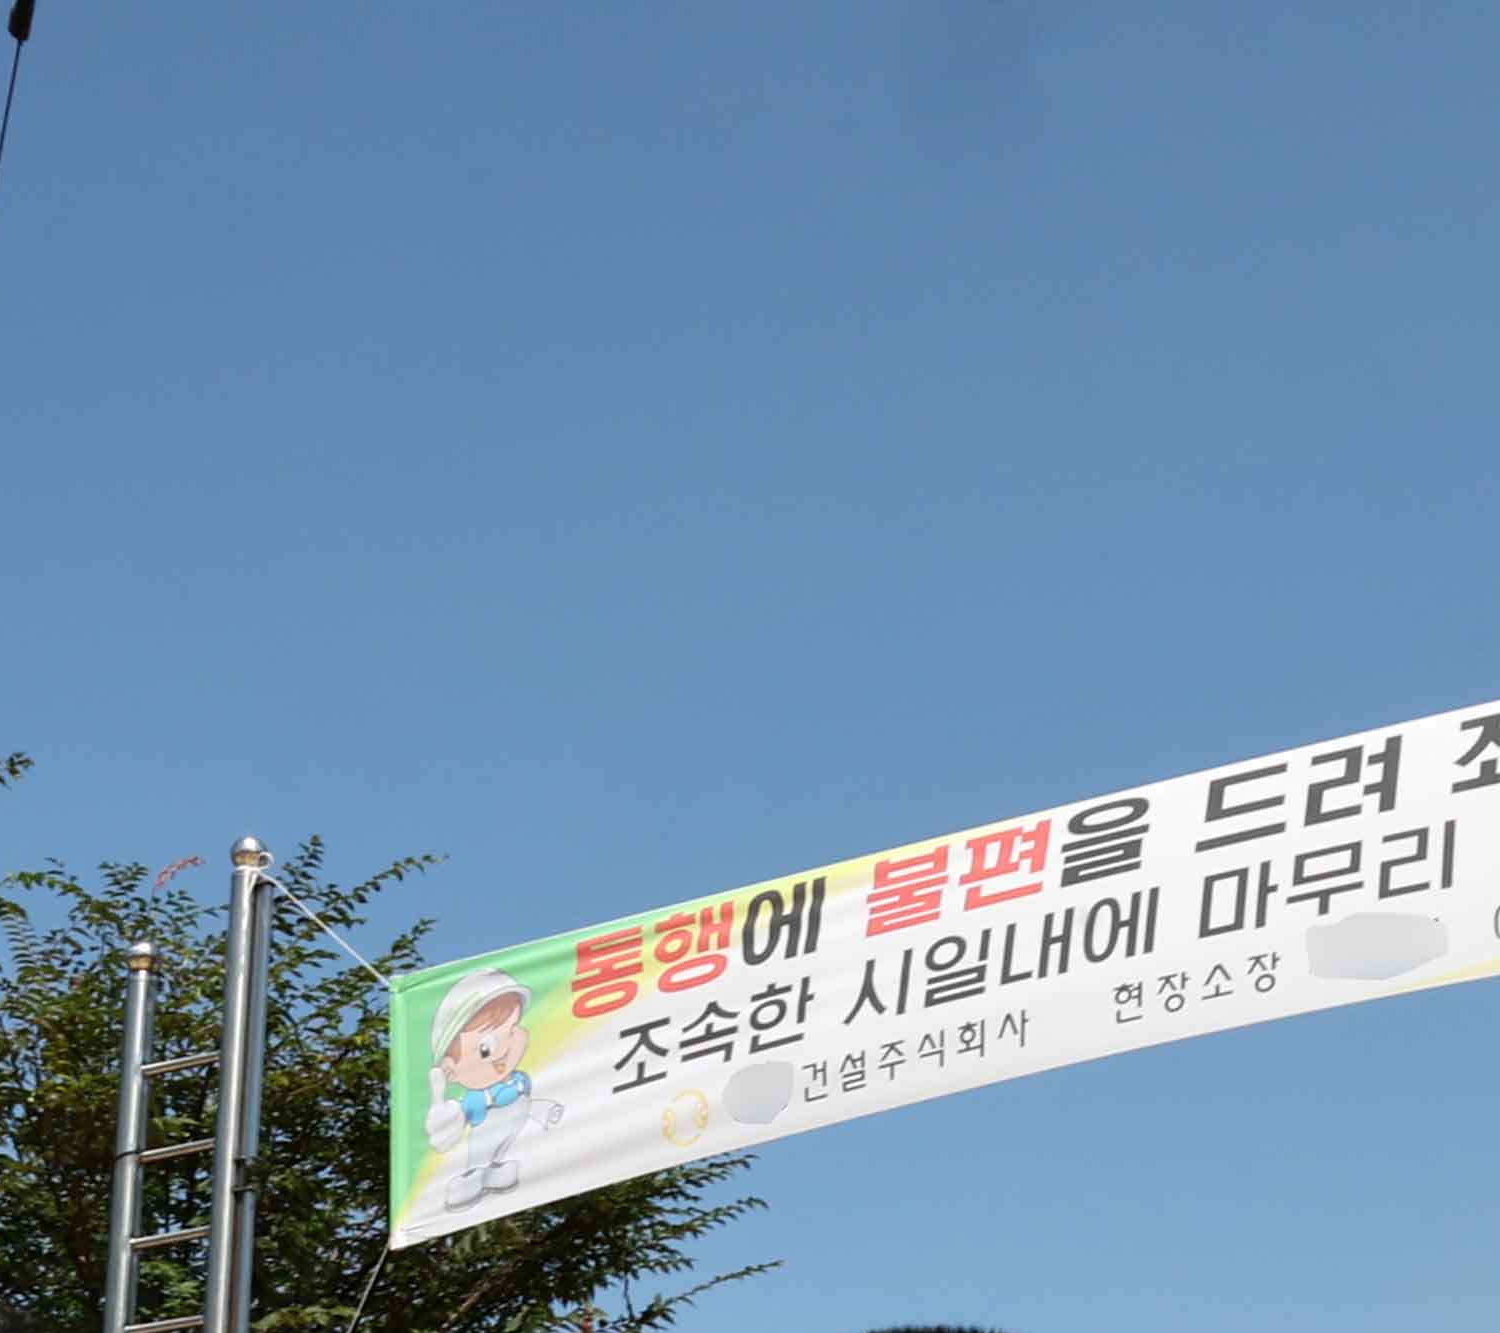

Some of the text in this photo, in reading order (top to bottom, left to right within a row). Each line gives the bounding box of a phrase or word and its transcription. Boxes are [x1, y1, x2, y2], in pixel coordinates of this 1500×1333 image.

[569, 875, 828, 1021] 통행에
[865, 796, 1151, 938] 불편을
[1193, 735, 1403, 857] 드려
[611, 976, 815, 1095] 조속한
[843, 886, 1162, 1026] 시일내에
[1196, 820, 1459, 940] 마무리
[1113, 951, 1282, 1025] 현장소장
